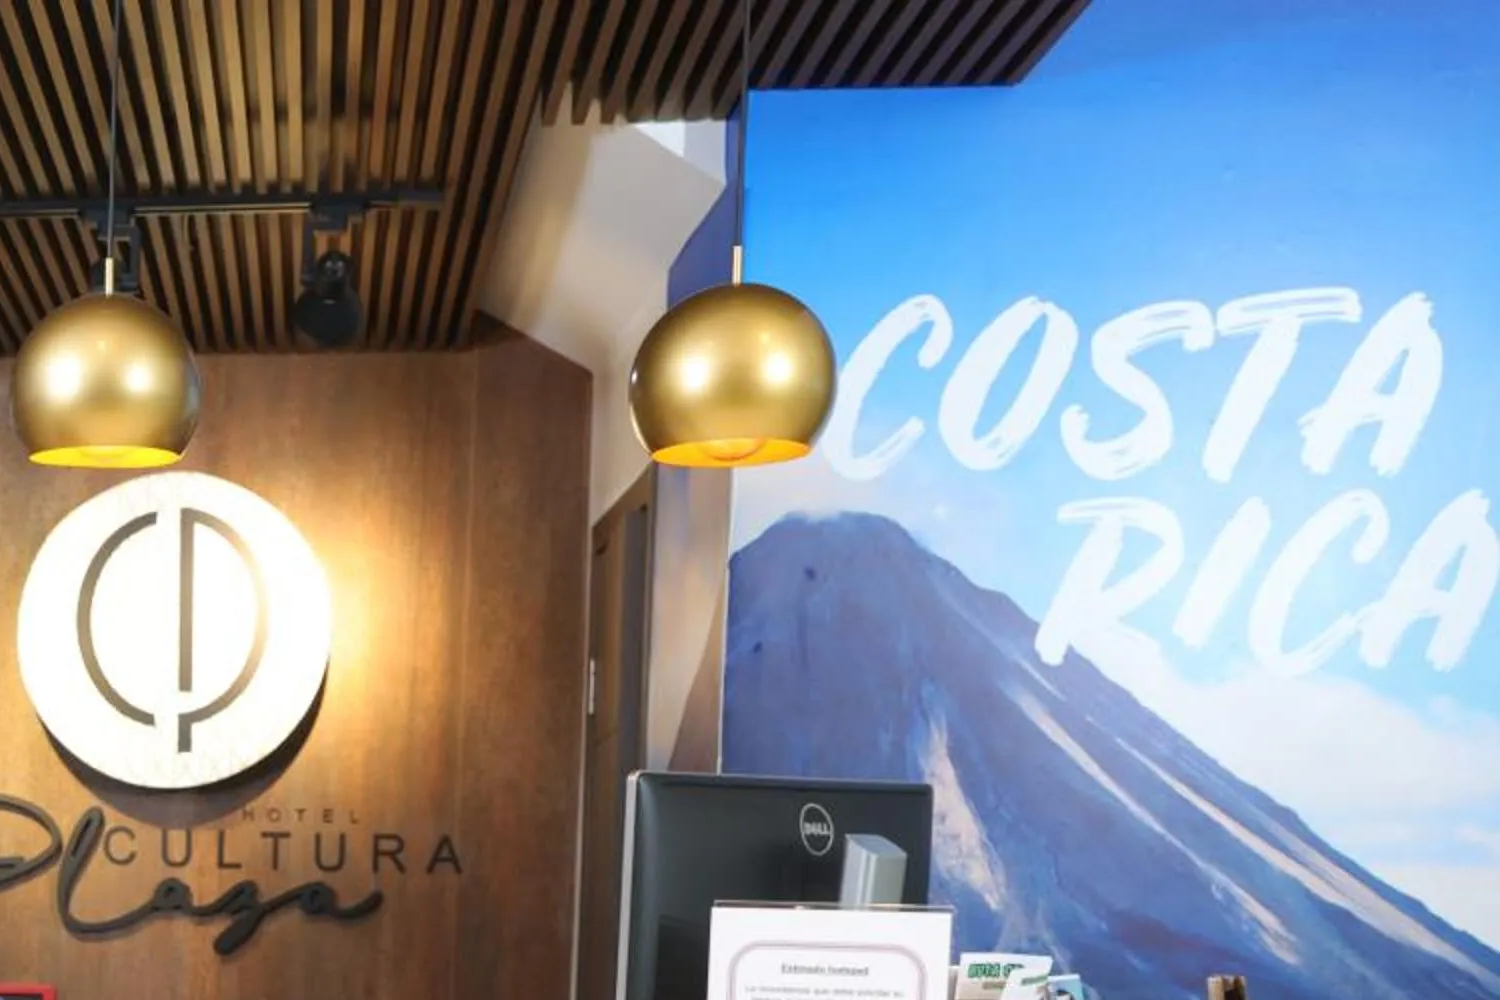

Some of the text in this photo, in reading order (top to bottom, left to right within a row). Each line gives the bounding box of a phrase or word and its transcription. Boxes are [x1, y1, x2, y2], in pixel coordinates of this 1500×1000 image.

[822, 286, 1443, 483] COSTA
[1034, 488, 1499, 677] RICA
[242, 807, 360, 825] HOTEL
[803, 821, 831, 836] DELL
[102, 825, 465, 875] CULTURA
